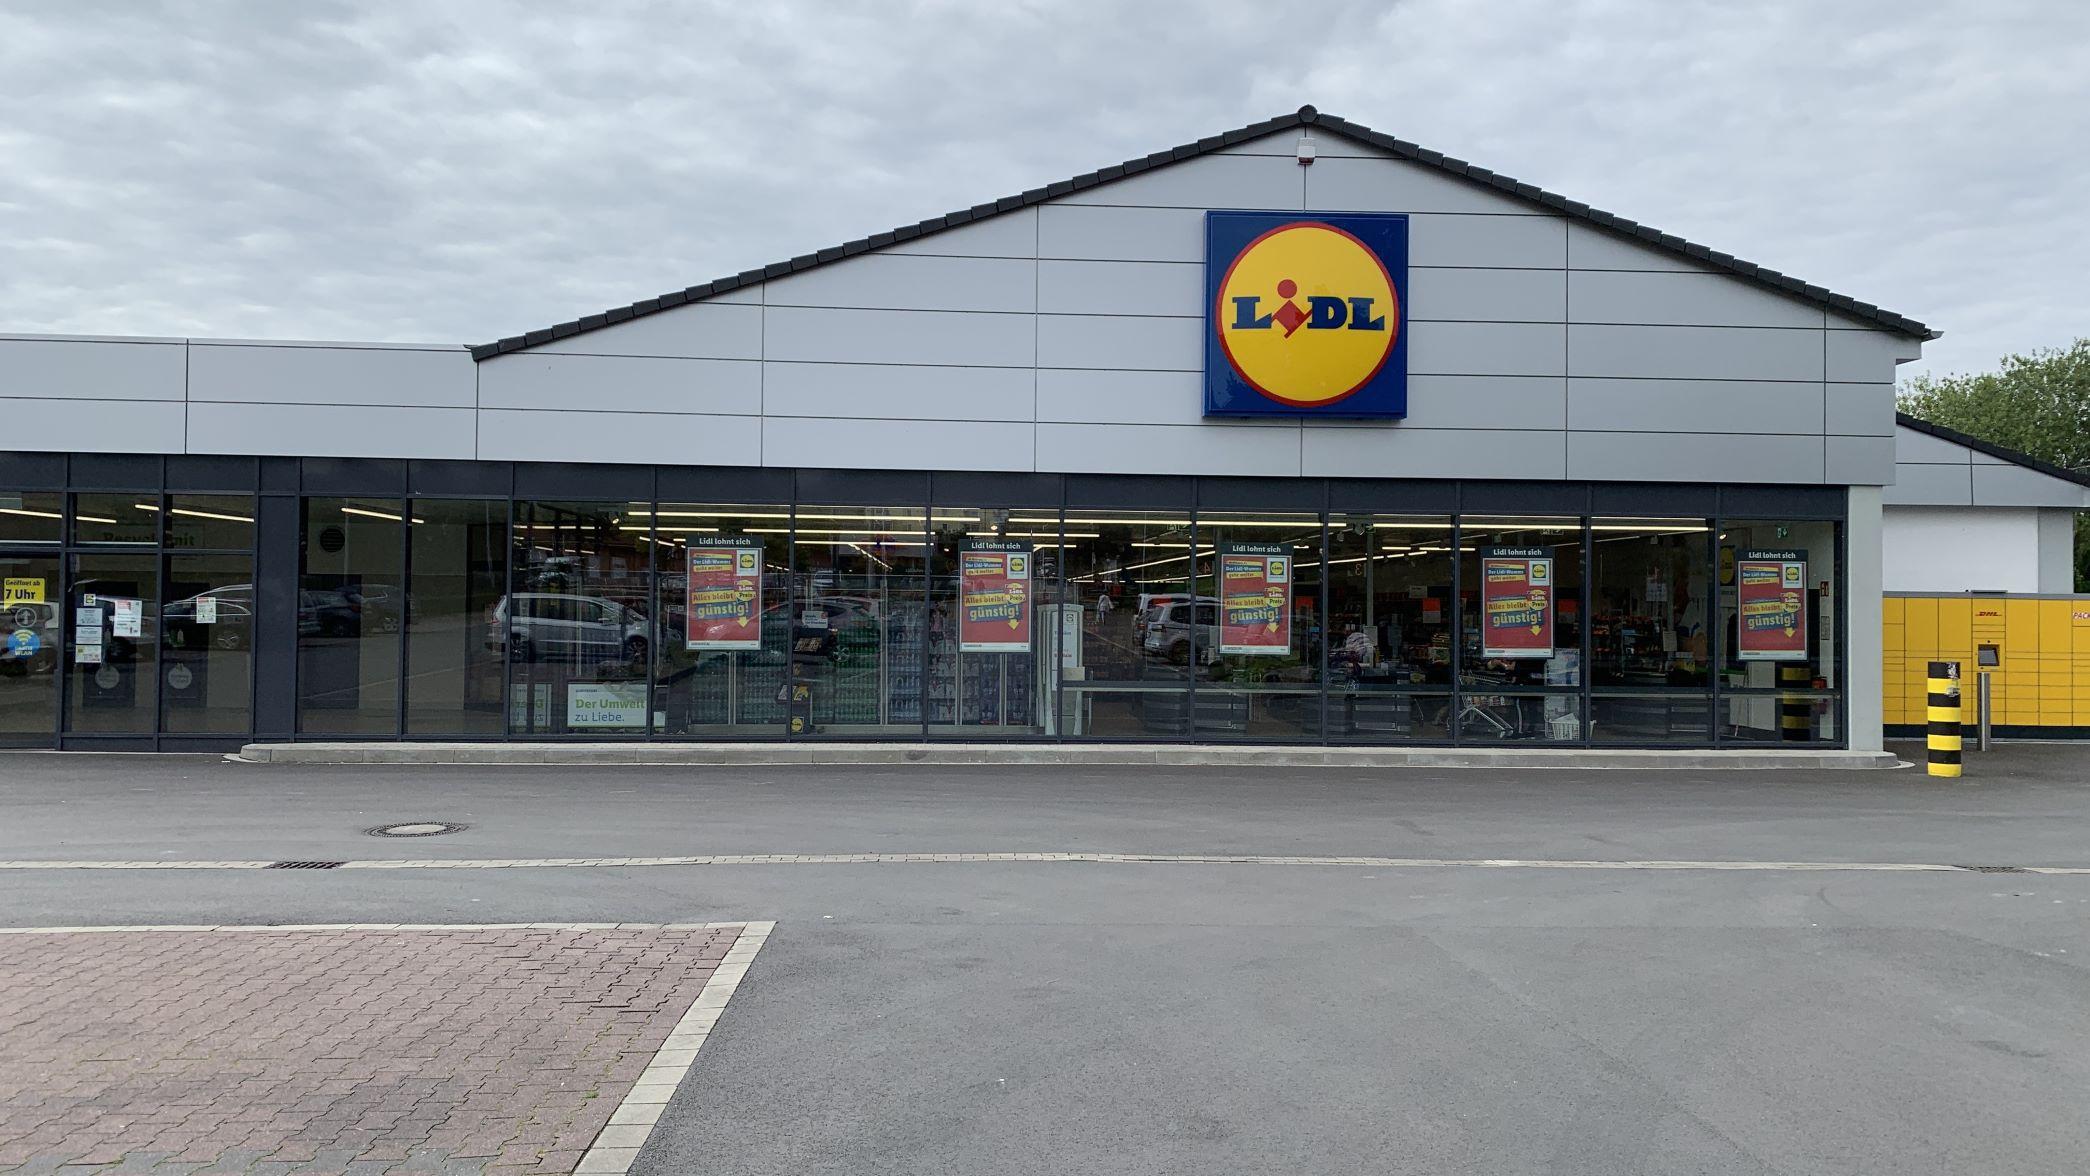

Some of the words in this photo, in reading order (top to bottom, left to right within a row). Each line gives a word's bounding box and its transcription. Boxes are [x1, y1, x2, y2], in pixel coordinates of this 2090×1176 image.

[6, 589, 12, 599] 7
[15, 589, 36, 599] Uhr
[712, 592, 733, 600] bleibt
[965, 596, 983, 604] Alles
[1226, 598, 1243, 606] Alles
[1244, 597, 1264, 605] bleibt
[698, 602, 749, 619] günstig!
[969, 605, 1019, 621] günstig!
[1230, 608, 1279, 624] günstig!
[1493, 611, 1542, 627] günstig!
[1747, 613, 1795, 630] günstig!
[575, 699, 597, 709] Der
[600, 699, 645, 709] Umwelt
[575, 714, 588, 722] zu
[592, 712, 625, 722] Liebe.
